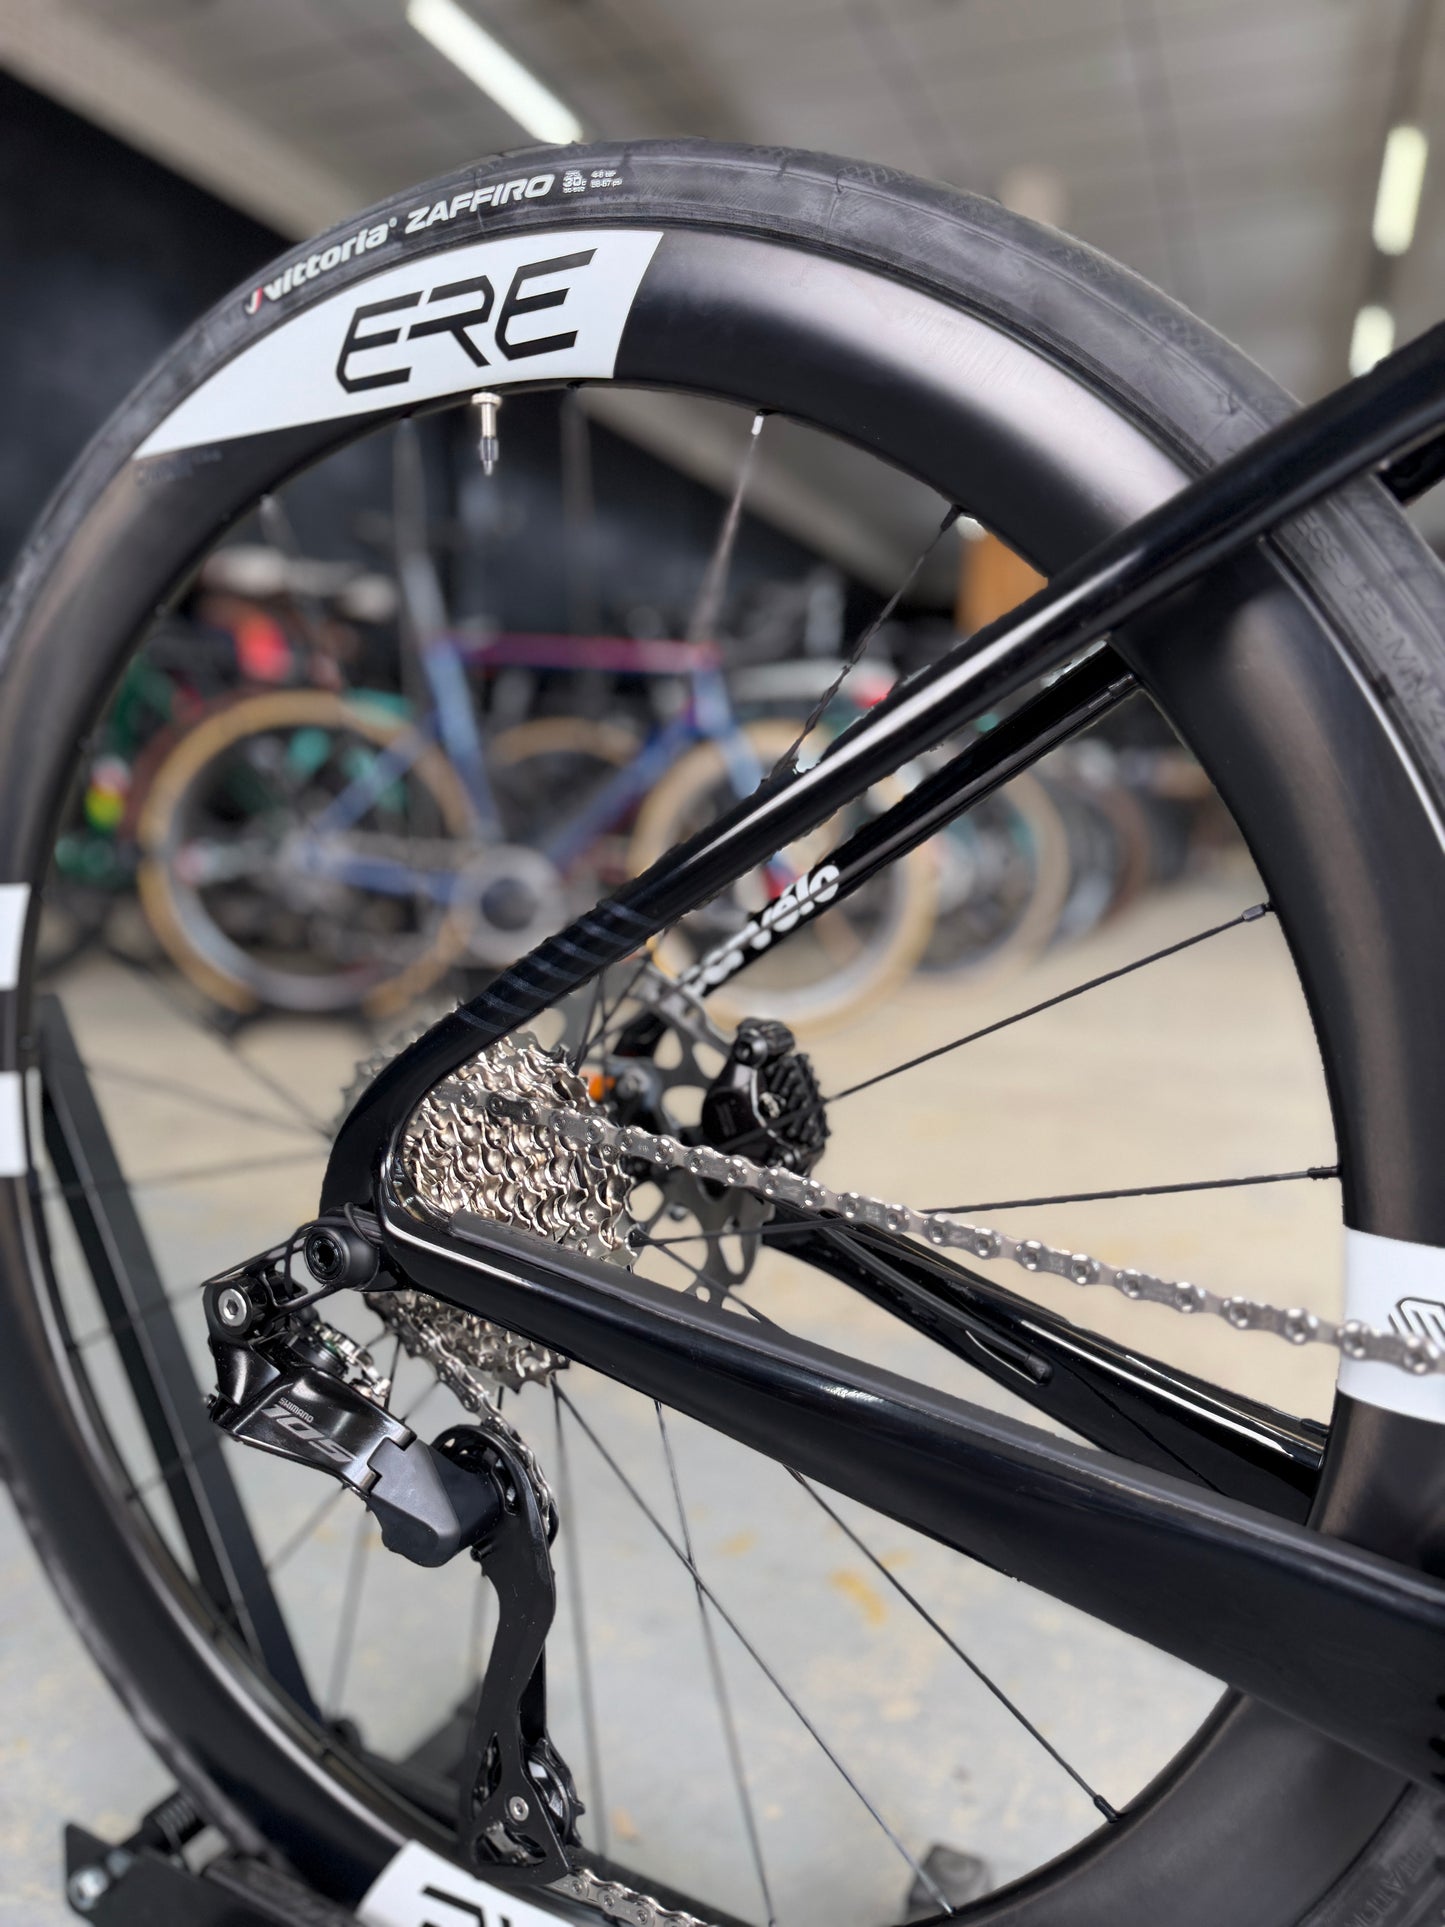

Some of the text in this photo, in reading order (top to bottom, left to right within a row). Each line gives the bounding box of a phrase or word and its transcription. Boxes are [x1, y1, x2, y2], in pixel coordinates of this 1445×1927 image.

[405, 174, 555, 234] ZAFFIRO
[336, 248, 598, 393] ERE
[261, 1404, 358, 1463] 105
[278, 1397, 315, 1423] SHIMANO
